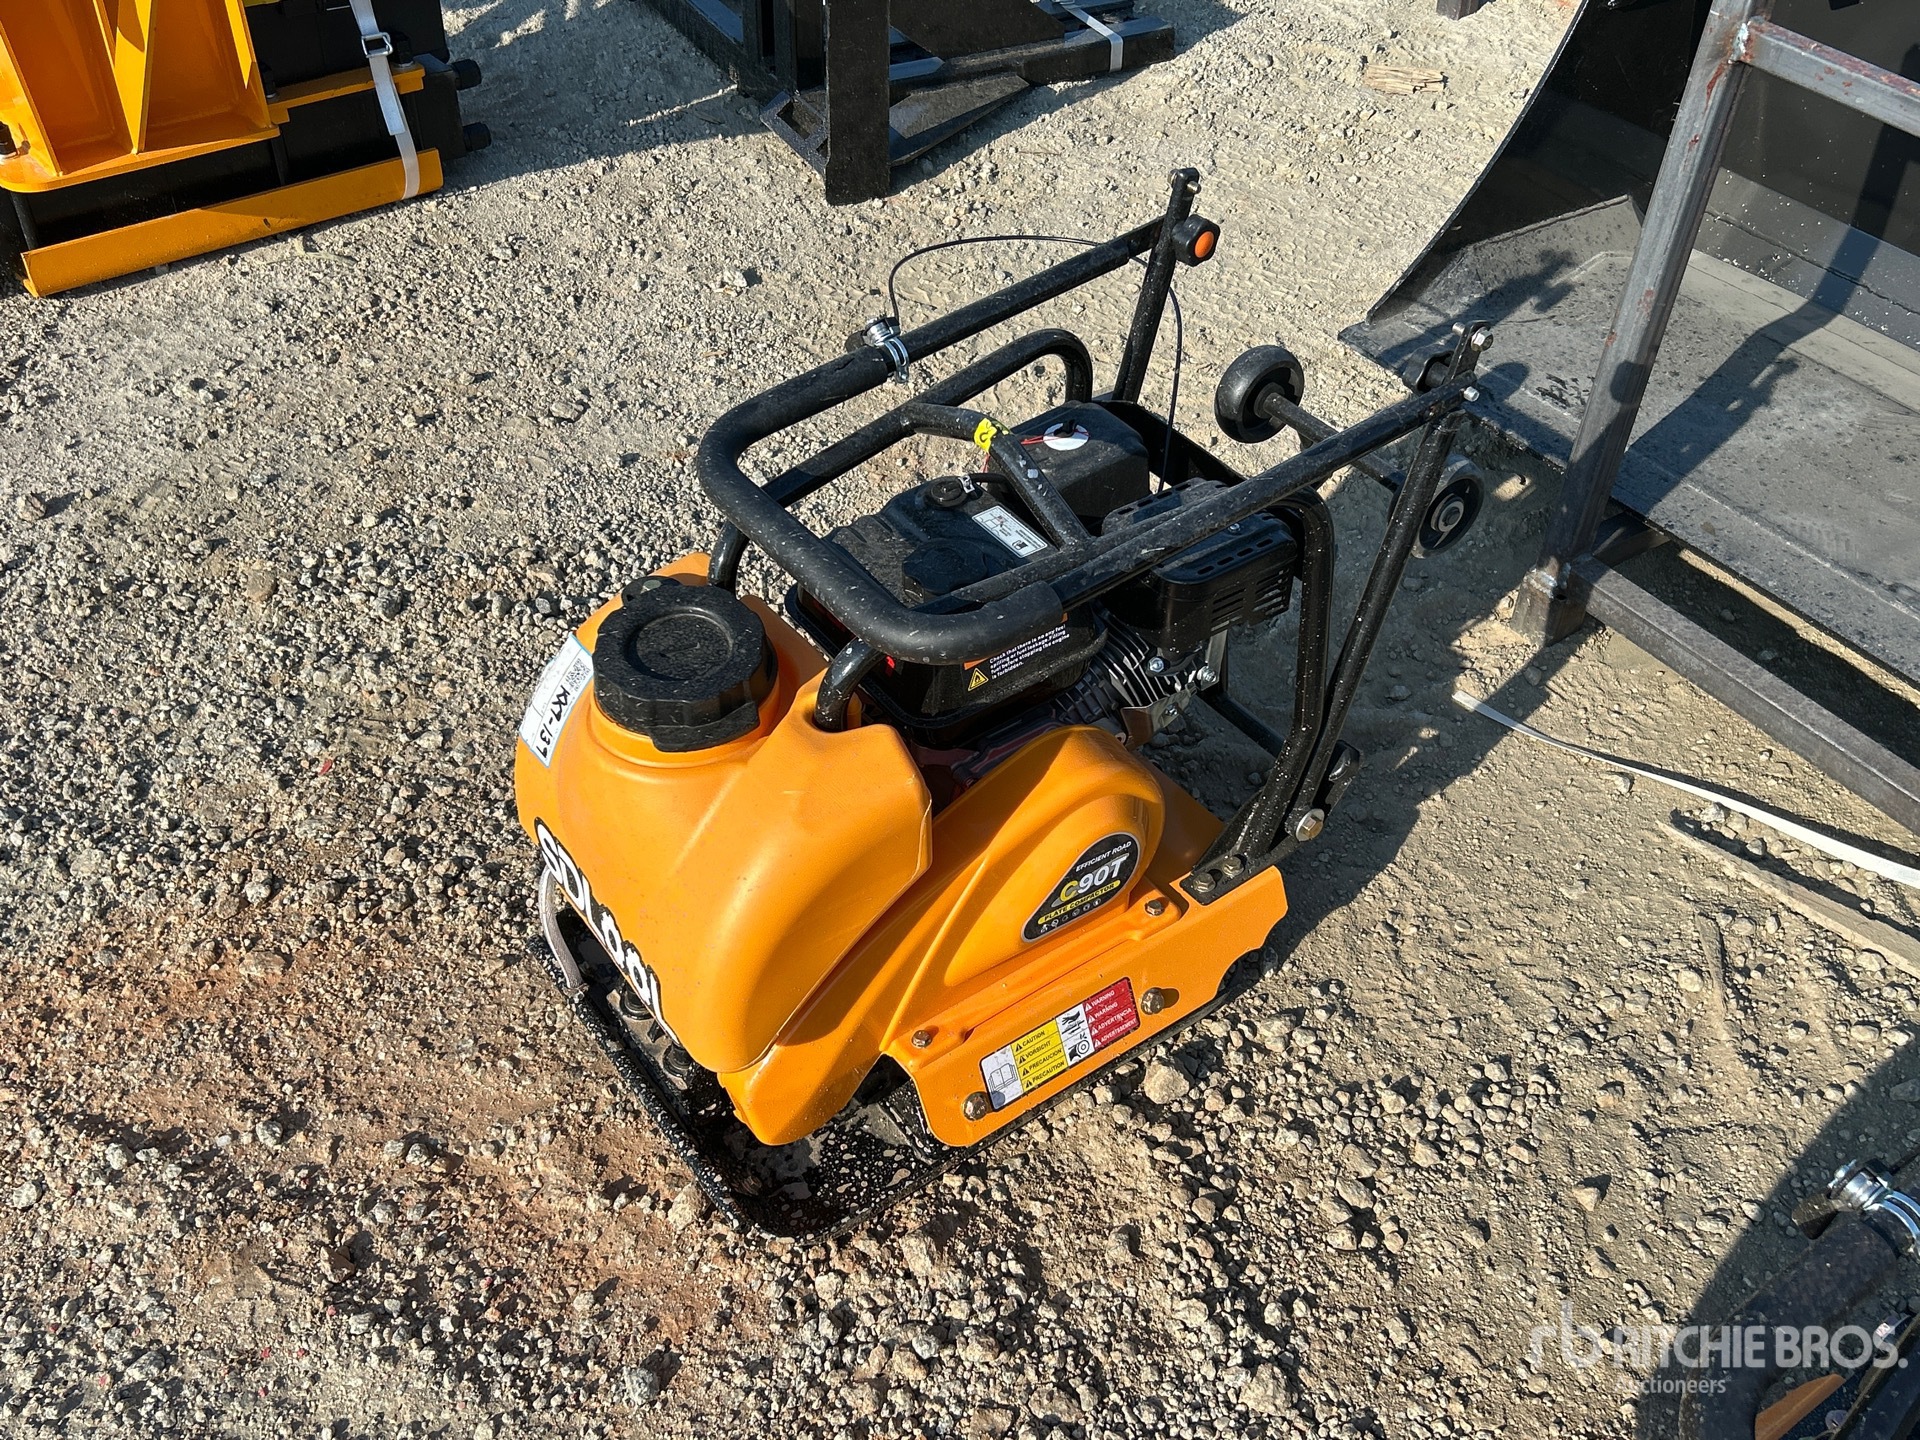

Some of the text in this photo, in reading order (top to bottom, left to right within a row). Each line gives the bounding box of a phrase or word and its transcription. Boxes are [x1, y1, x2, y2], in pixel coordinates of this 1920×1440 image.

[989, 652, 1006, 664] Check
[1006, 646, 1017, 655] that
[1017, 640, 1031, 650] there
[1055, 623, 1066, 632] fuel
[1017, 647, 1027, 656] fuel
[990, 666, 1002, 675] fuel
[1001, 657, 1019, 669] before
[1019, 646, 1043, 660] stopping
[1075, 841, 1132, 872] EFFICIENT ROAD
[1059, 855, 1128, 902] C90T
[1044, 883, 1115, 922] PLATE COMPACTOR
[1091, 989, 1115, 1007] WARNING
[1097, 1008, 1132, 1030] ADVERTENCIA
[1021, 1030, 1046, 1047] CAUTION
[1025, 1040, 1052, 1059] VORSICHT
[1028, 1048, 1062, 1071] PRECAUCION
[1032, 1060, 1065, 1083] PRECAUTION
